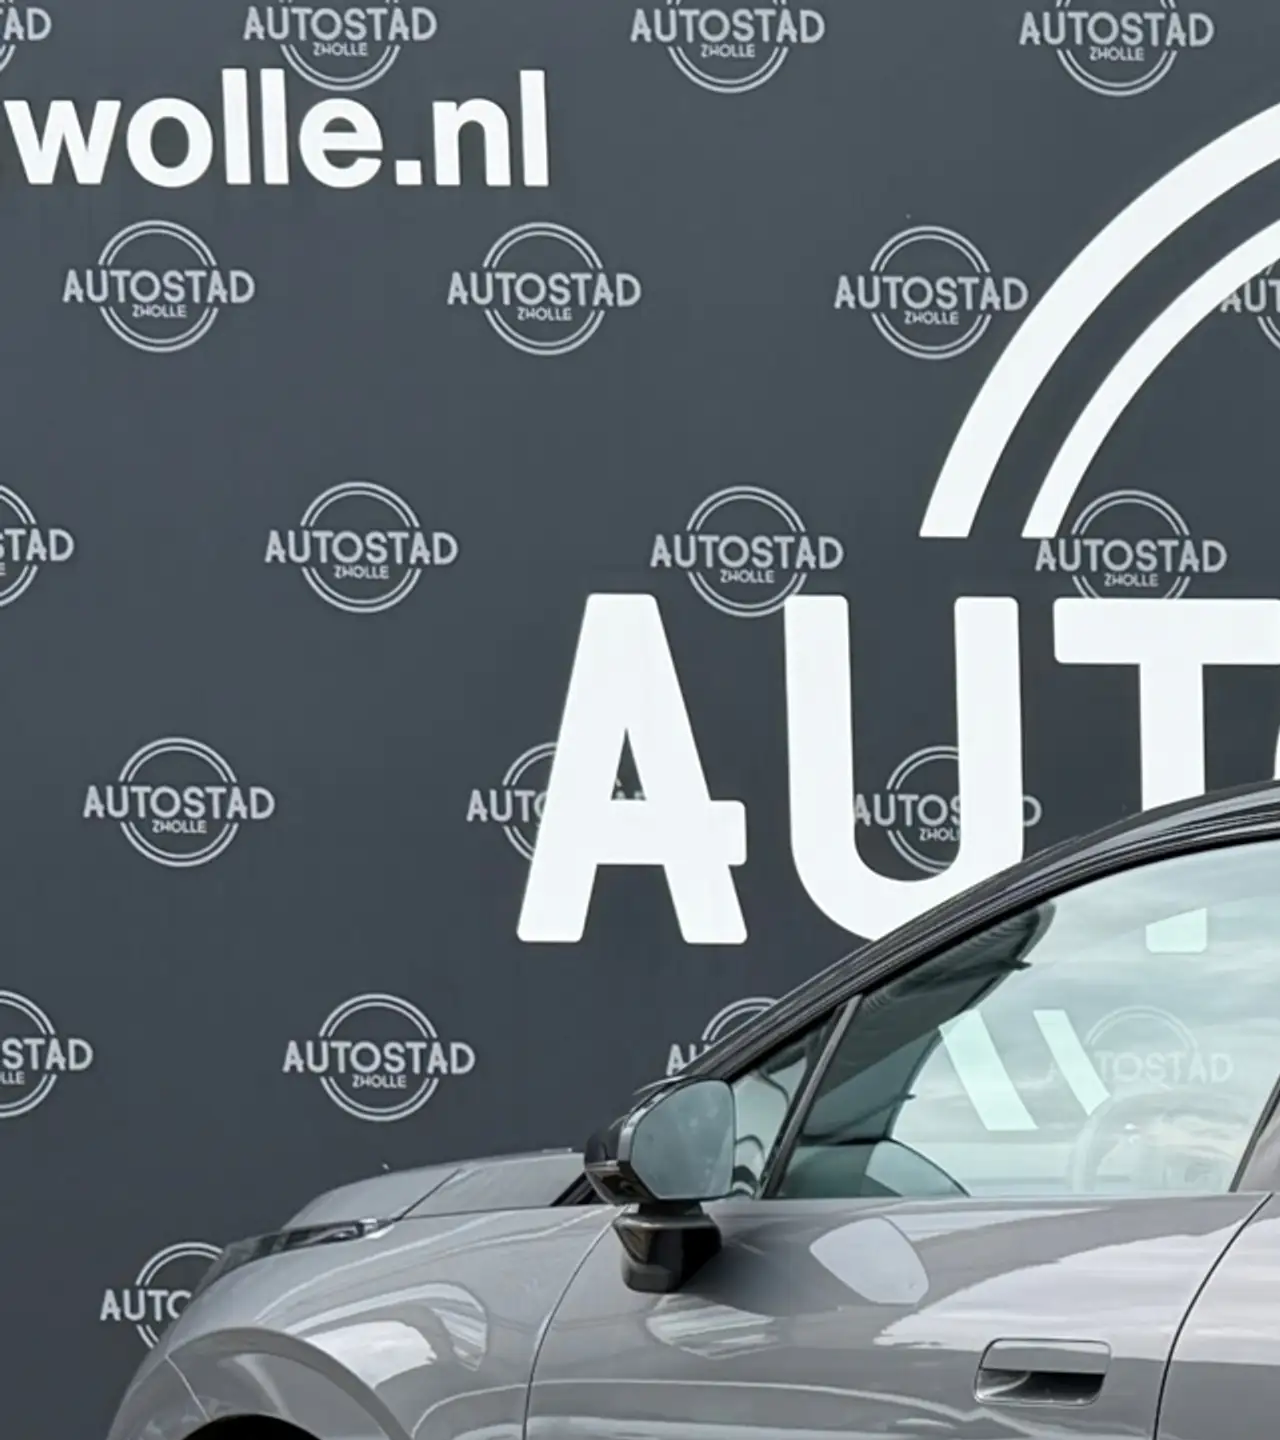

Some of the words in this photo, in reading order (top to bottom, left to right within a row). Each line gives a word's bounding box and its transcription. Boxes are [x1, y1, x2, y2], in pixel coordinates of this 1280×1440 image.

[243, 7, 437, 41] AUTOSTAD
[630, 8, 825, 43] AUTOSTAD
[1019, 12, 1214, 47] AUTOSTAD
[4, 68, 549, 188] wolle.nl
[62, 269, 255, 303] AUTOSTAD
[447, 272, 641, 307] AUTOSTAD
[834, 275, 1028, 309] AUTOSTAD
[265, 530, 458, 565] AUTOSTAD
[650, 534, 844, 569] AUTOSTAD
[1035, 538, 1227, 572] AUTOSTAD
[83, 785, 275, 819] AUTOSTAD
[282, 1040, 475, 1074] AUTOSTAD
